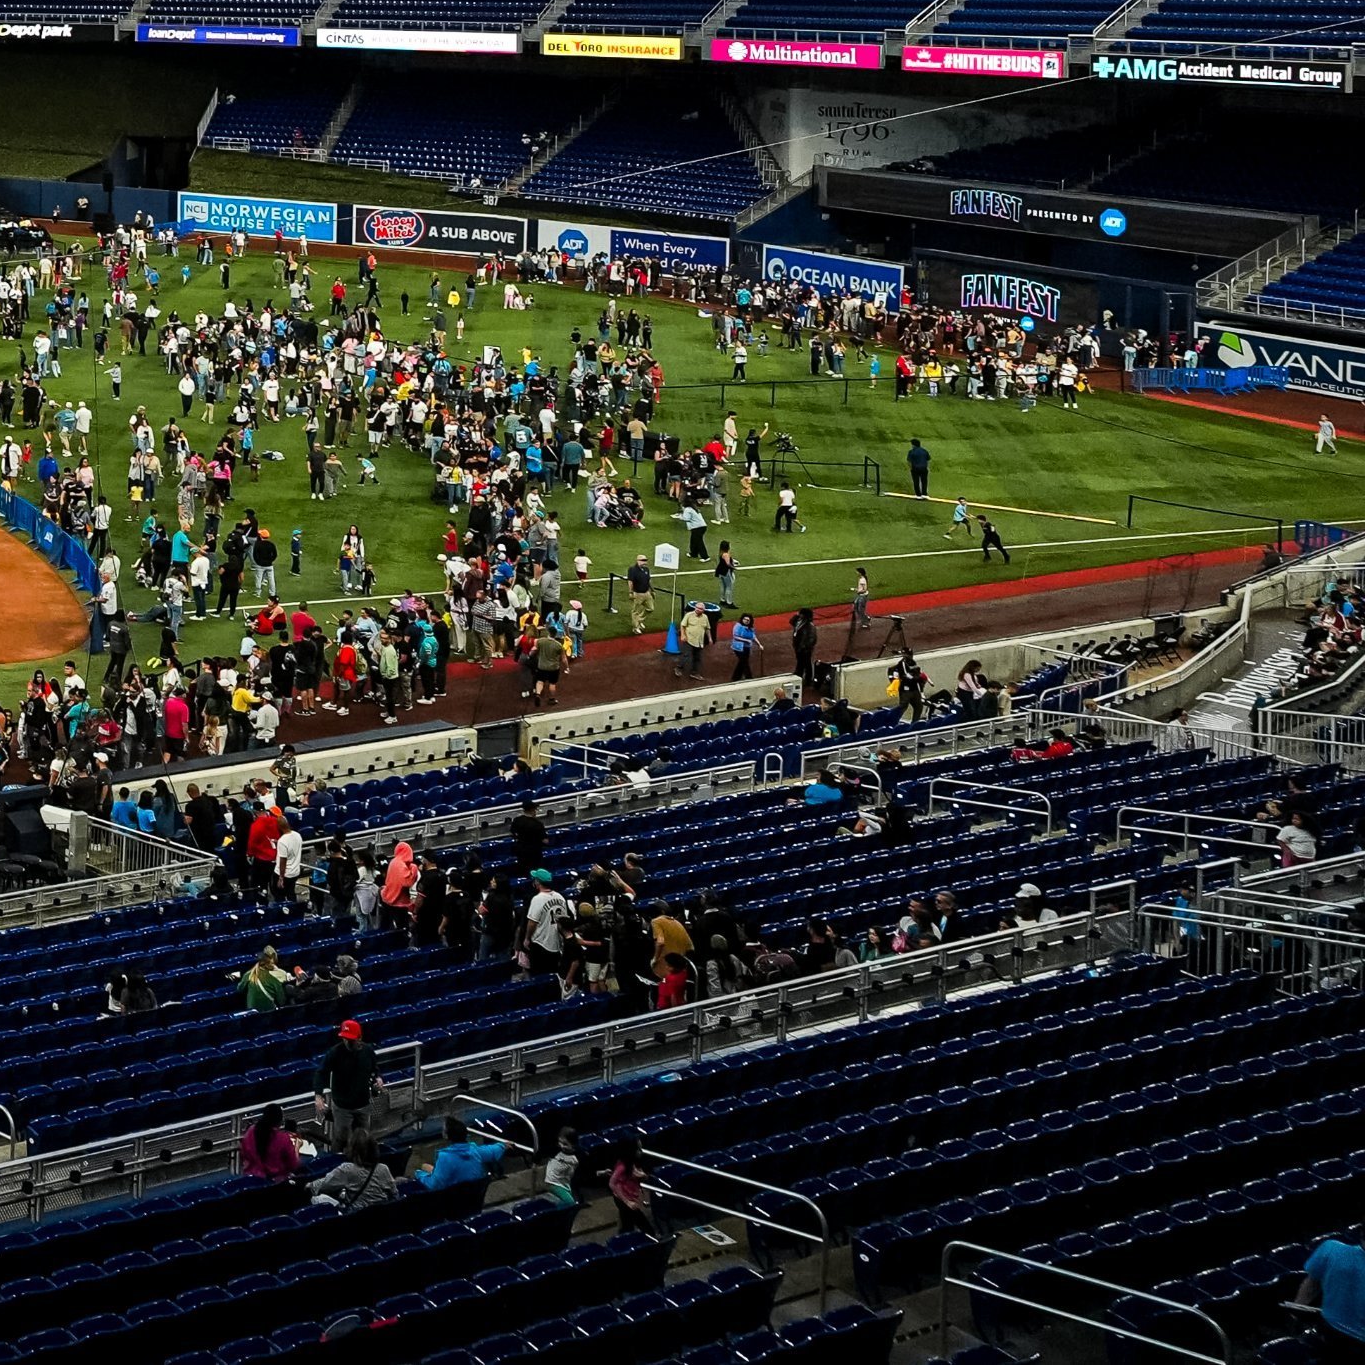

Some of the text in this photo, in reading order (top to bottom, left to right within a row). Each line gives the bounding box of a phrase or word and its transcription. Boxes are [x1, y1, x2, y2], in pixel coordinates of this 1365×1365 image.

[41, 24, 72, 39] park
[148, 28, 196, 40] loanDepot
[248, 32, 285, 42] Everything
[548, 43, 570, 52] DEL
[607, 45, 675, 56] INSURANCE
[749, 44, 857, 65] Multinational
[943, 53, 1041, 72] #HITTHEBUDS
[1114, 58, 1341, 85] AMG Accident Medical Group
[483, 195, 499, 206] 387
[950, 189, 1022, 223] FANFEST
[1027, 209, 1078, 222] PRESENTED
[1082, 215, 1093, 224] BY
[186, 202, 330, 223] NCL NORWEGIAN
[372, 214, 416, 228] Jersey
[211, 215, 264, 230] CRUISE
[429, 226, 515, 245] A SUB ABOVE
[562, 239, 584, 250] ADT
[623, 238, 697, 258] When Every
[790, 265, 896, 299] OCEAN BANK
[961, 274, 1060, 323] FANFEST
